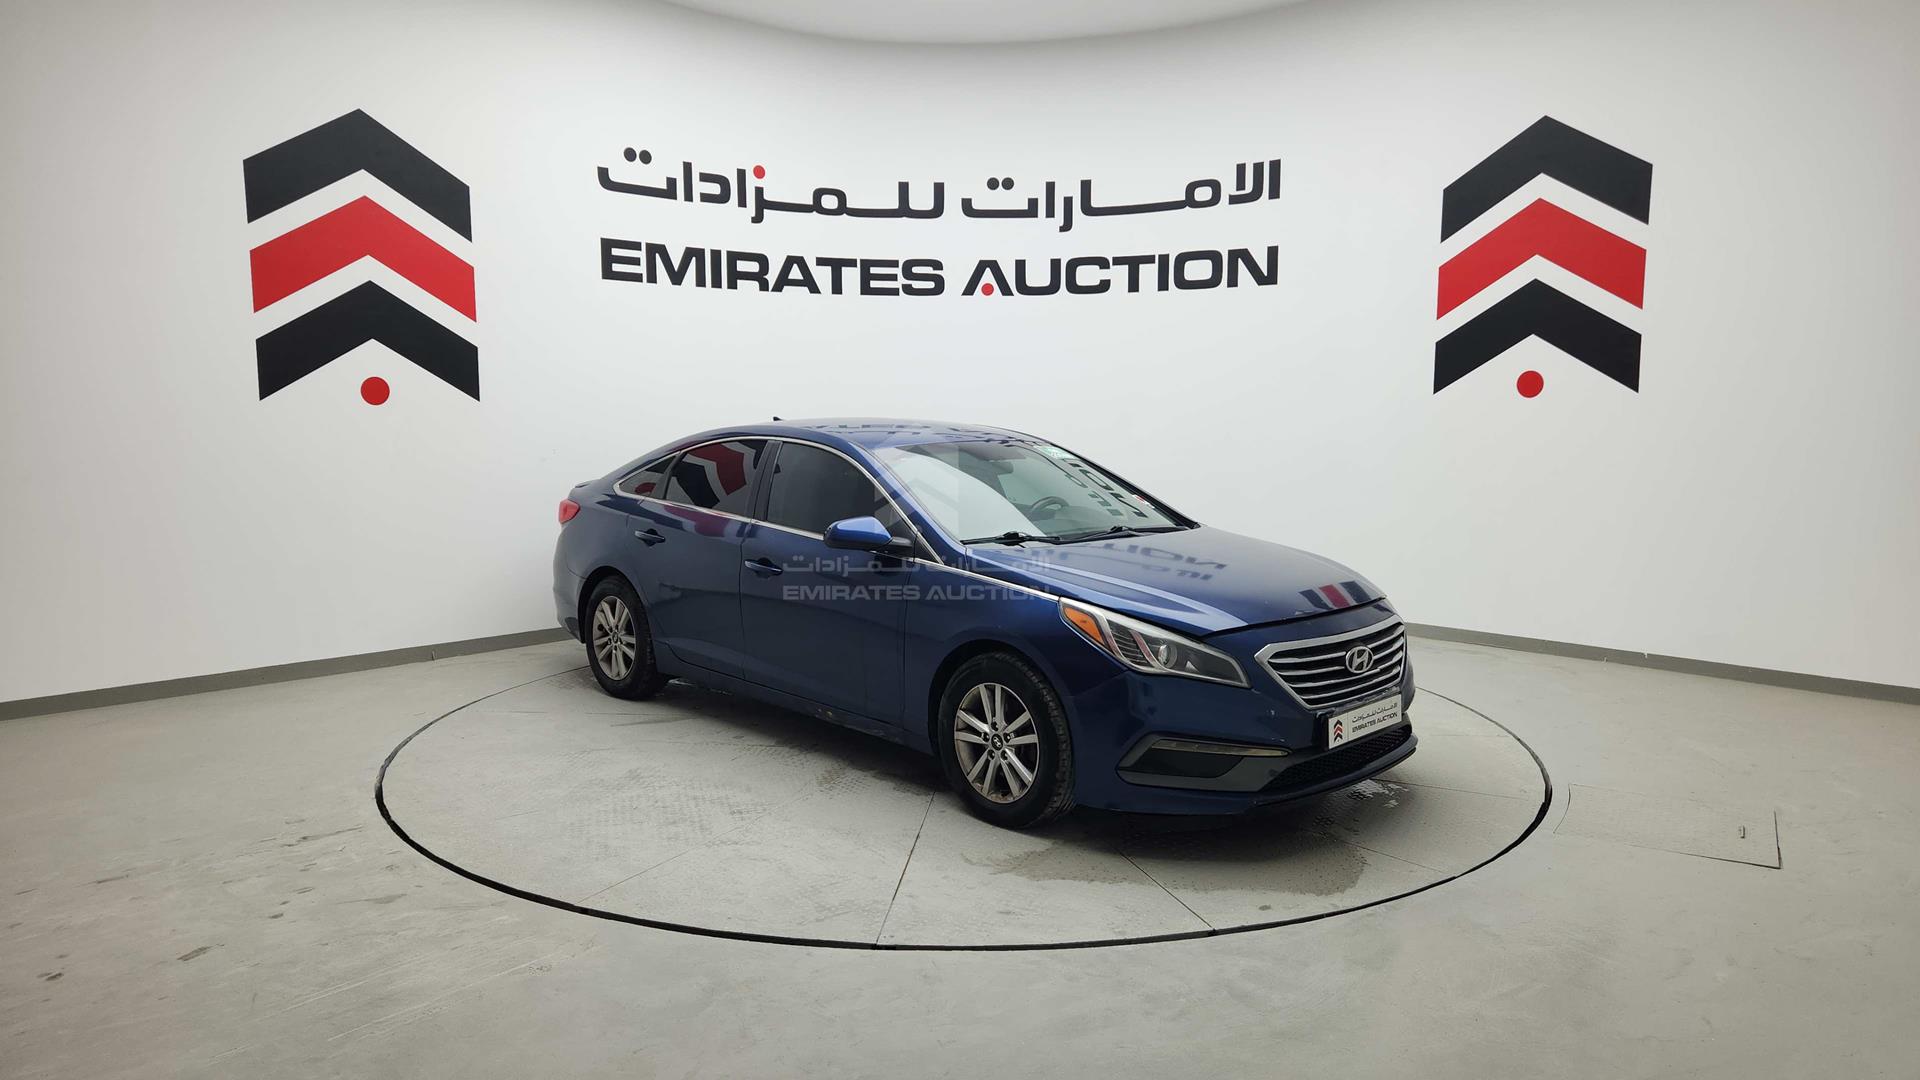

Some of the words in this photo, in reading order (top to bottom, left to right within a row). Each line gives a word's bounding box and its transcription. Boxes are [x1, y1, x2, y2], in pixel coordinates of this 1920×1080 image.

[598, 148, 944, 223] للمزادات
[962, 159, 1280, 232] الامارات
[601, 238, 944, 296] EMIRATES
[962, 246, 1278, 296] AUCTION
[1376, 712, 1398, 724] AUCTION
